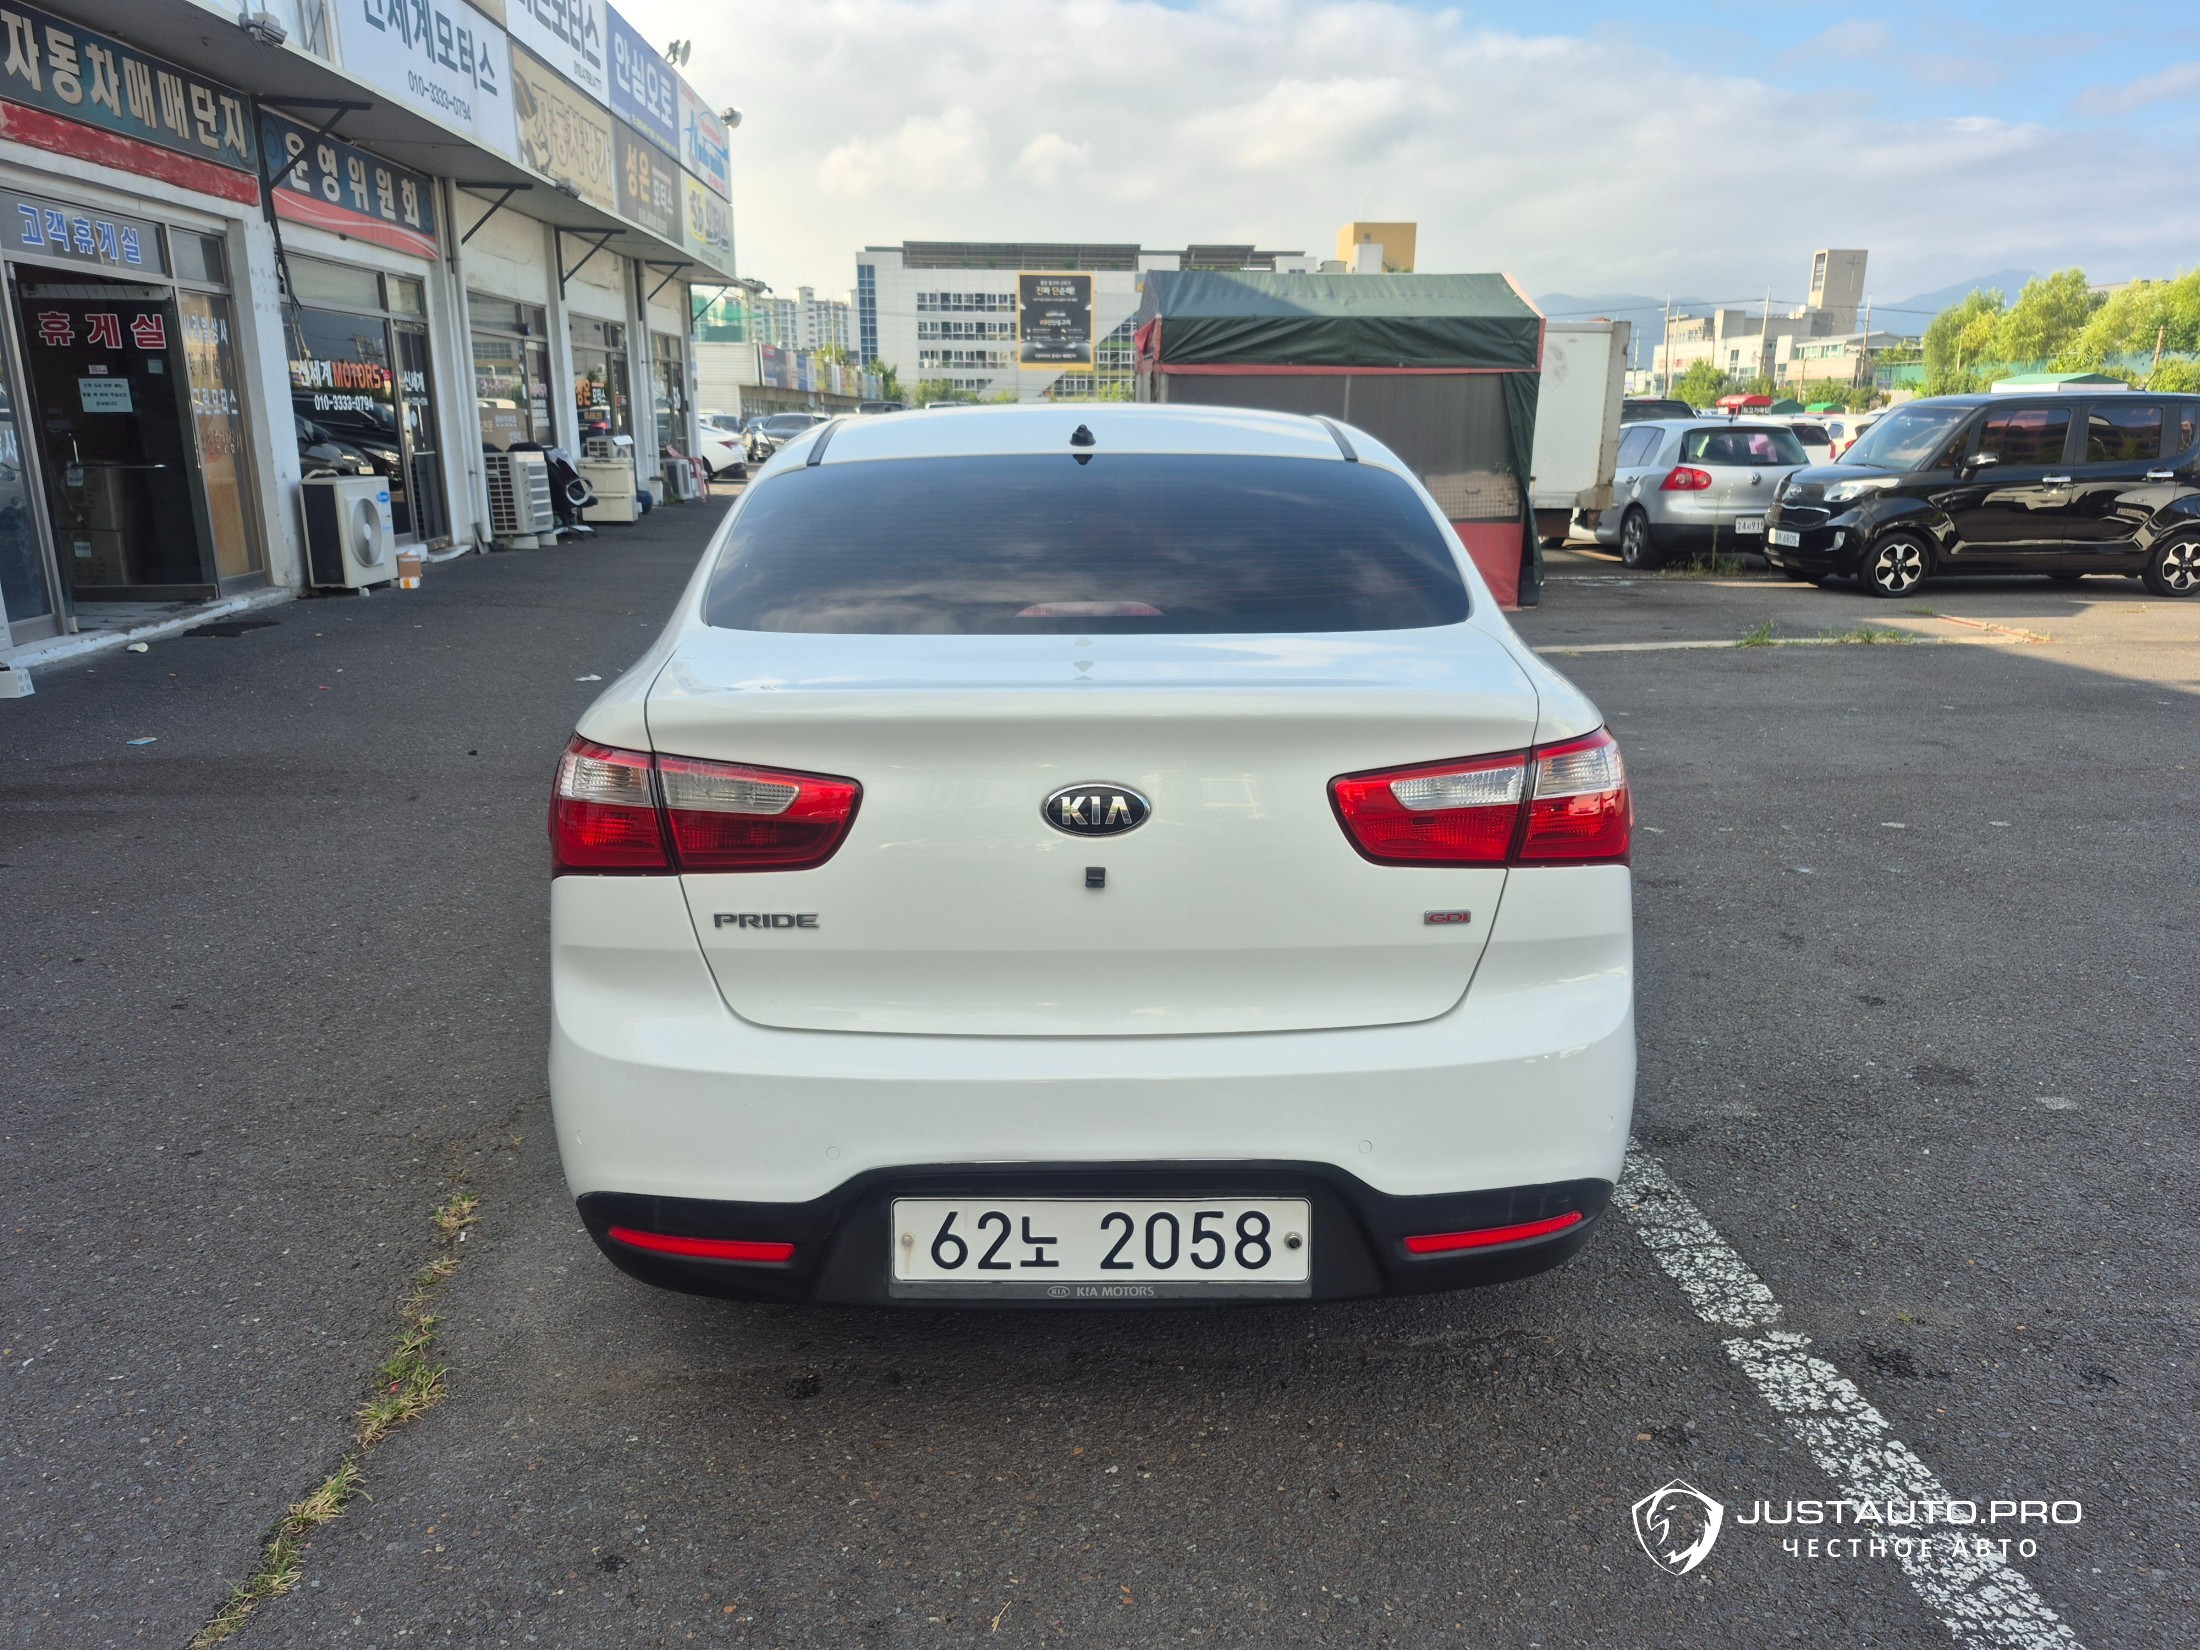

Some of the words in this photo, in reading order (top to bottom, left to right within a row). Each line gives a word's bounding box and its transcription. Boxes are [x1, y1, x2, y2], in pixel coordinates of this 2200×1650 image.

[518, 0, 601, 70] 모터스
[1, 10, 248, 159] 자동차매매단지
[408, 70, 471, 122] 010-3333-0794
[285, 132, 421, 230] 운영위원회
[18, 204, 142, 265] 고객휴게실
[38, 311, 167, 350] 휴게실
[314, 394, 374, 411] 010-3333-0794
[1061, 796, 1132, 825] KIA
[714, 913, 820, 928] PRIDE
[1429, 913, 1468, 922] GDI
[931, 1210, 1059, 1270] 62노
[1100, 1210, 1272, 1270] 2058
[1049, 1287, 1067, 1296] KIA
[1077, 1287, 1098, 1296] KIA
[1102, 1286, 1155, 1296] MOTORS
